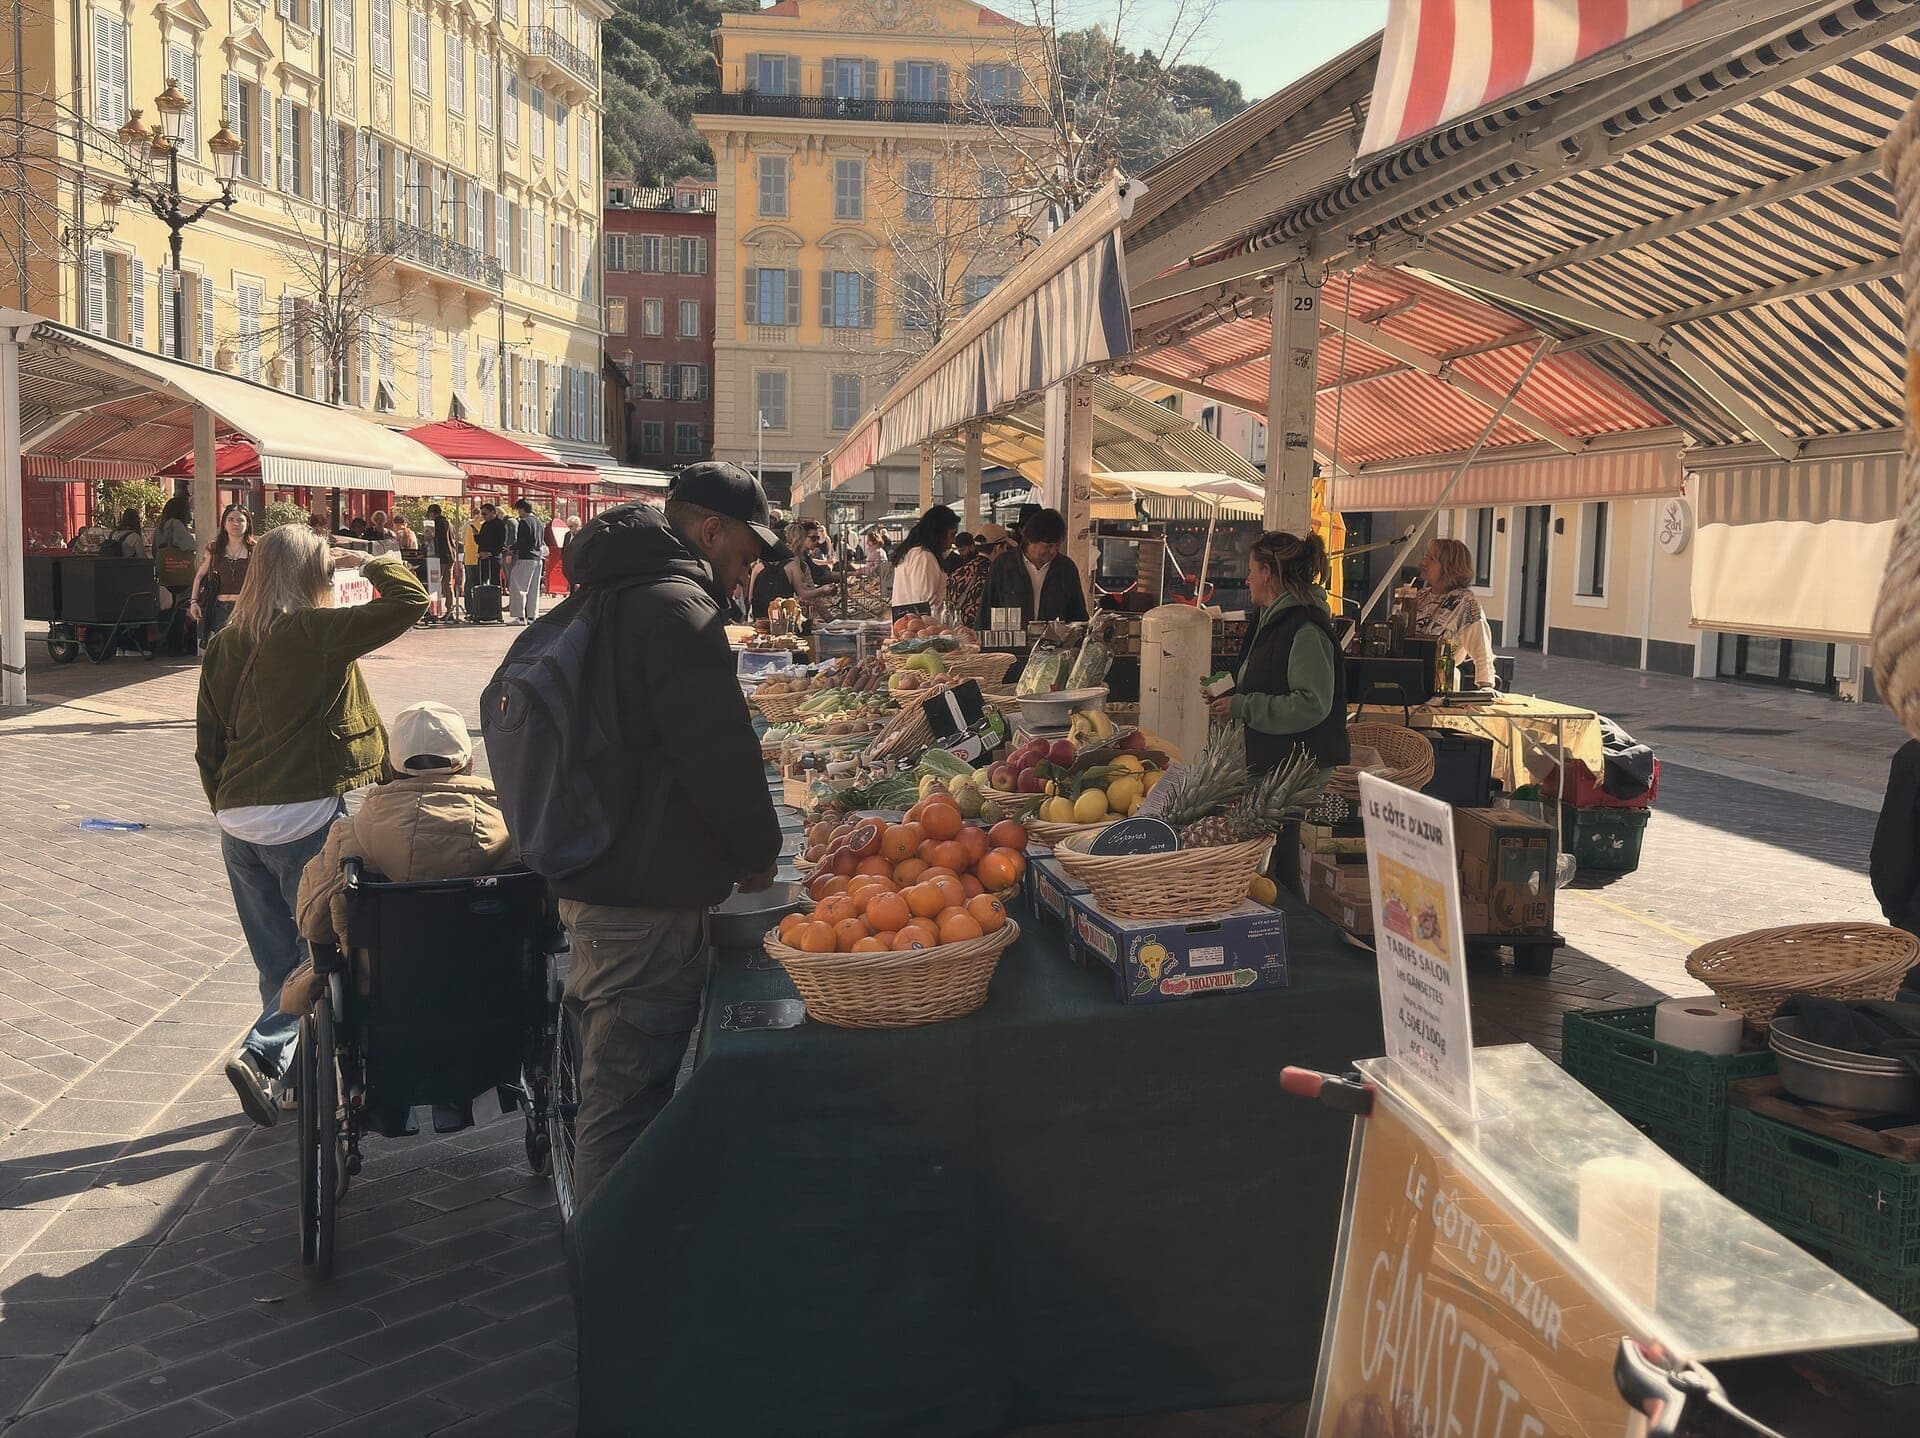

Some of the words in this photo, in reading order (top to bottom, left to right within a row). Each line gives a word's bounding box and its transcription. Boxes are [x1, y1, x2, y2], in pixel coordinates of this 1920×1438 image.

[1294, 297, 1313, 311] 29
[1369, 799, 1381, 820] LE
[1382, 802, 1407, 830] CÔTE
[1409, 817, 1444, 847] D'AZUR
[1189, 973, 1234, 990] MURATORI
[1386, 935, 1418, 967] TARIFS
[1419, 955, 1451, 987] SALON
[1407, 973, 1444, 1006] GANSETTES
[1405, 1160, 1428, 1211] LE
[1432, 1187, 1482, 1265] CÔTE
[1485, 1240, 1562, 1352] D'AZUR
[1361, 1244, 1544, 1438] GANSET
